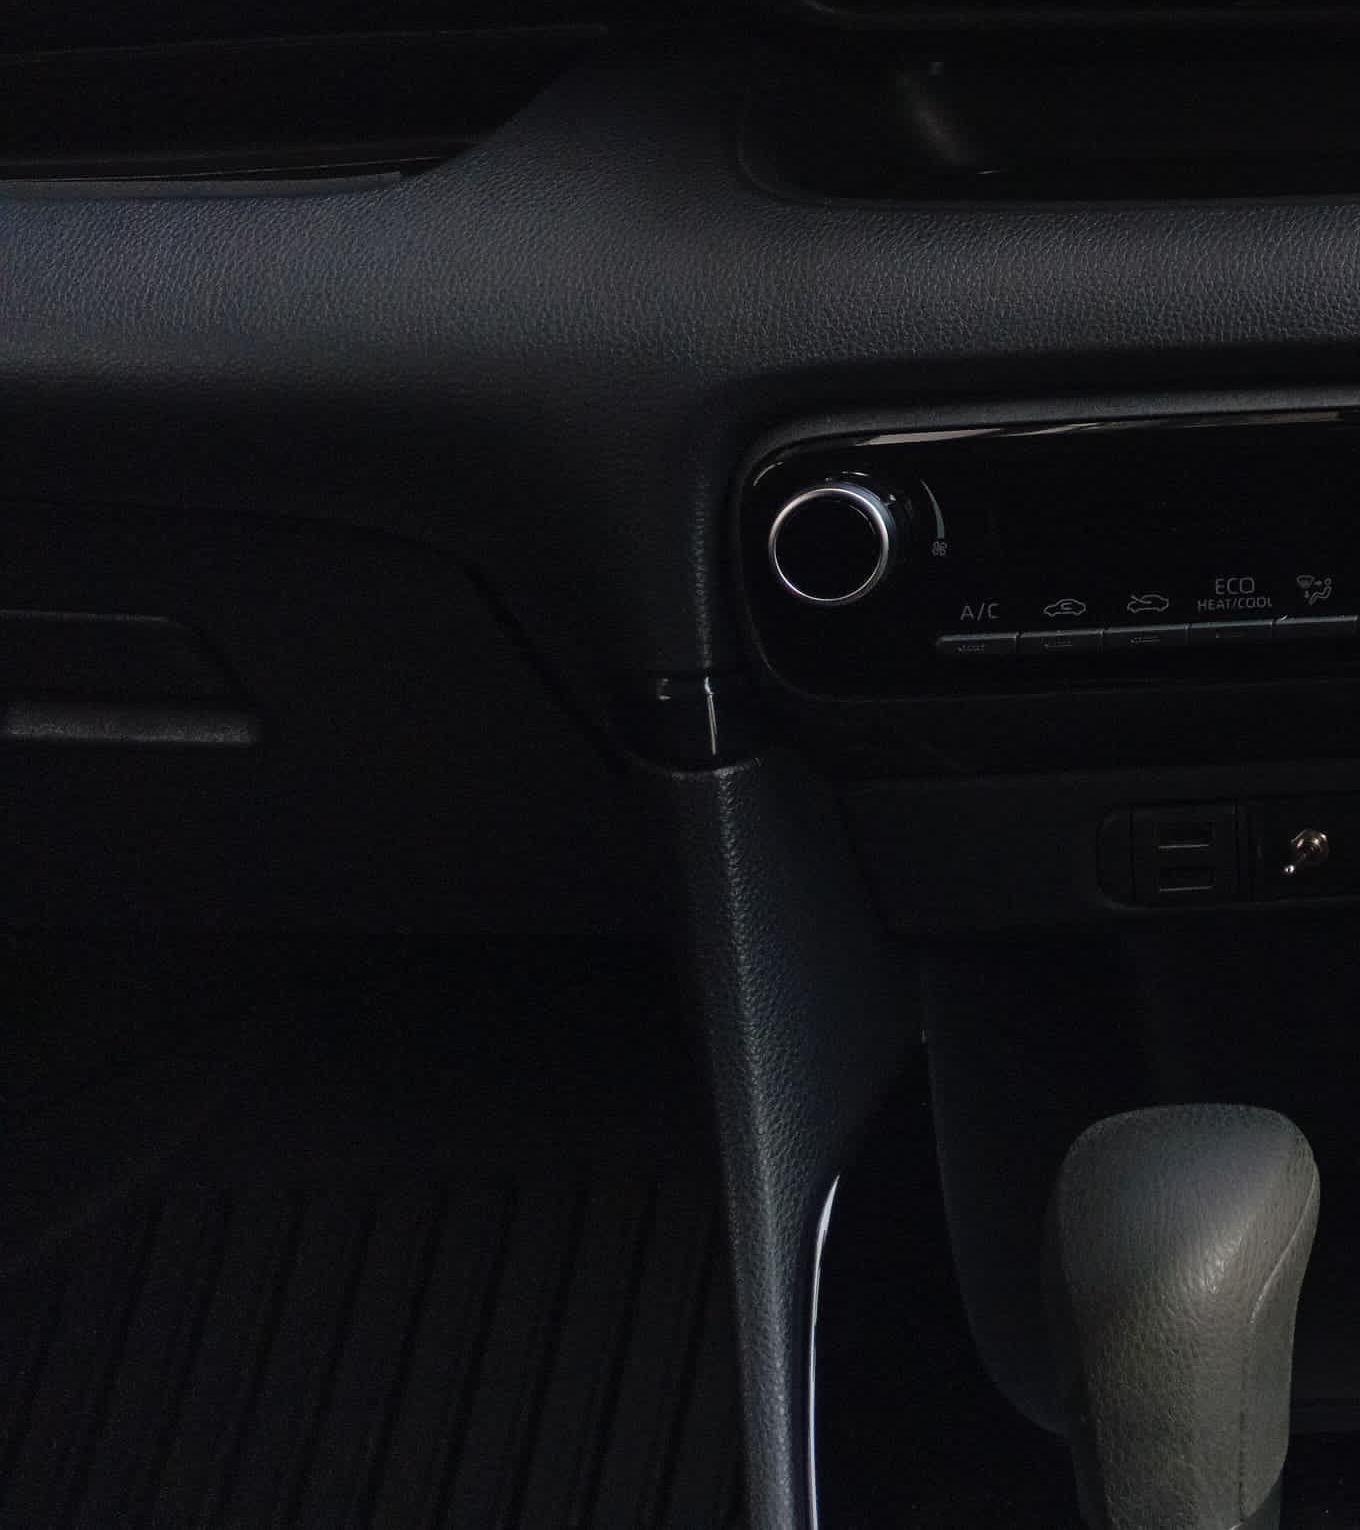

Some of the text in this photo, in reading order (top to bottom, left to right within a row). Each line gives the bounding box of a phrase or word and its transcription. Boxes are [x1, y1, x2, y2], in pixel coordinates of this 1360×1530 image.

[1214, 575, 1256, 596] ECO
[960, 602, 1000, 622] A/C
[1196, 596, 1273, 611] HEAT/COOL
